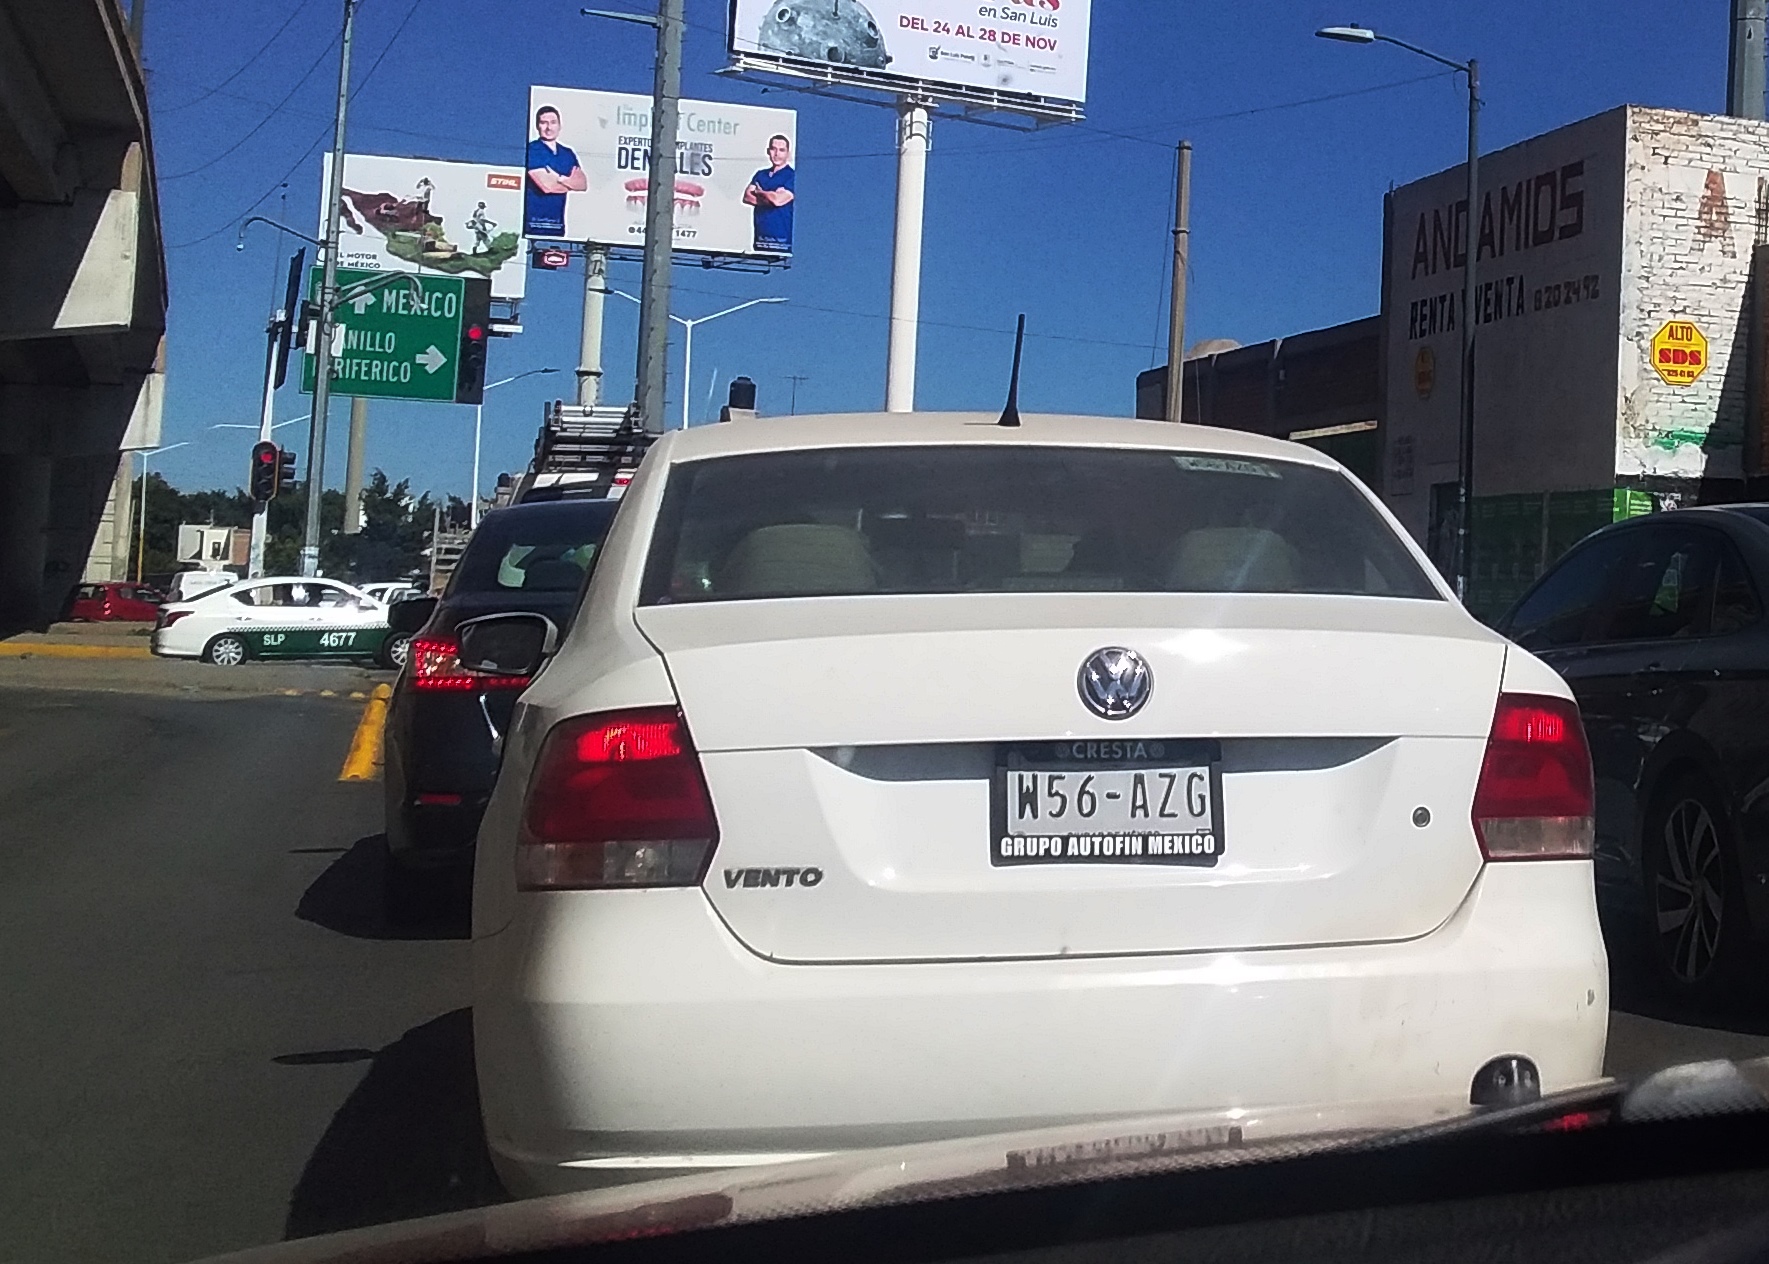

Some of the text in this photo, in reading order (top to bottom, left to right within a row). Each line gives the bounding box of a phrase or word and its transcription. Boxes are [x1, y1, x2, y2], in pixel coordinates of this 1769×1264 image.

[979, 6, 1058, 28] en San Luis
[899, 15, 1057, 51] DEL 24 AL 28 DE NOV
[687, 112, 740, 136] Center
[490, 177, 518, 187] STIHL
[1411, 160, 1584, 281] ANDAMIOS
[346, 252, 377, 260] MOTOR
[1409, 293, 1455, 340] RENTA
[1475, 274, 1525, 326] VENTA
[343, 329, 396, 354] NILLO
[1668, 325, 1692, 342] ALTO
[1658, 347, 1702, 366] SDS
[313, 356, 411, 384] RIFERICO
[263, 633, 286, 646] SLP
[319, 631, 357, 648] 4677
[1071, 741, 1148, 759] CRESTA
[1017, 772, 1207, 820] W56-AZG
[1000, 834, 1216, 857] GRUPO AUTOFIN MEXICO
[723, 867, 824, 889] VENTO
